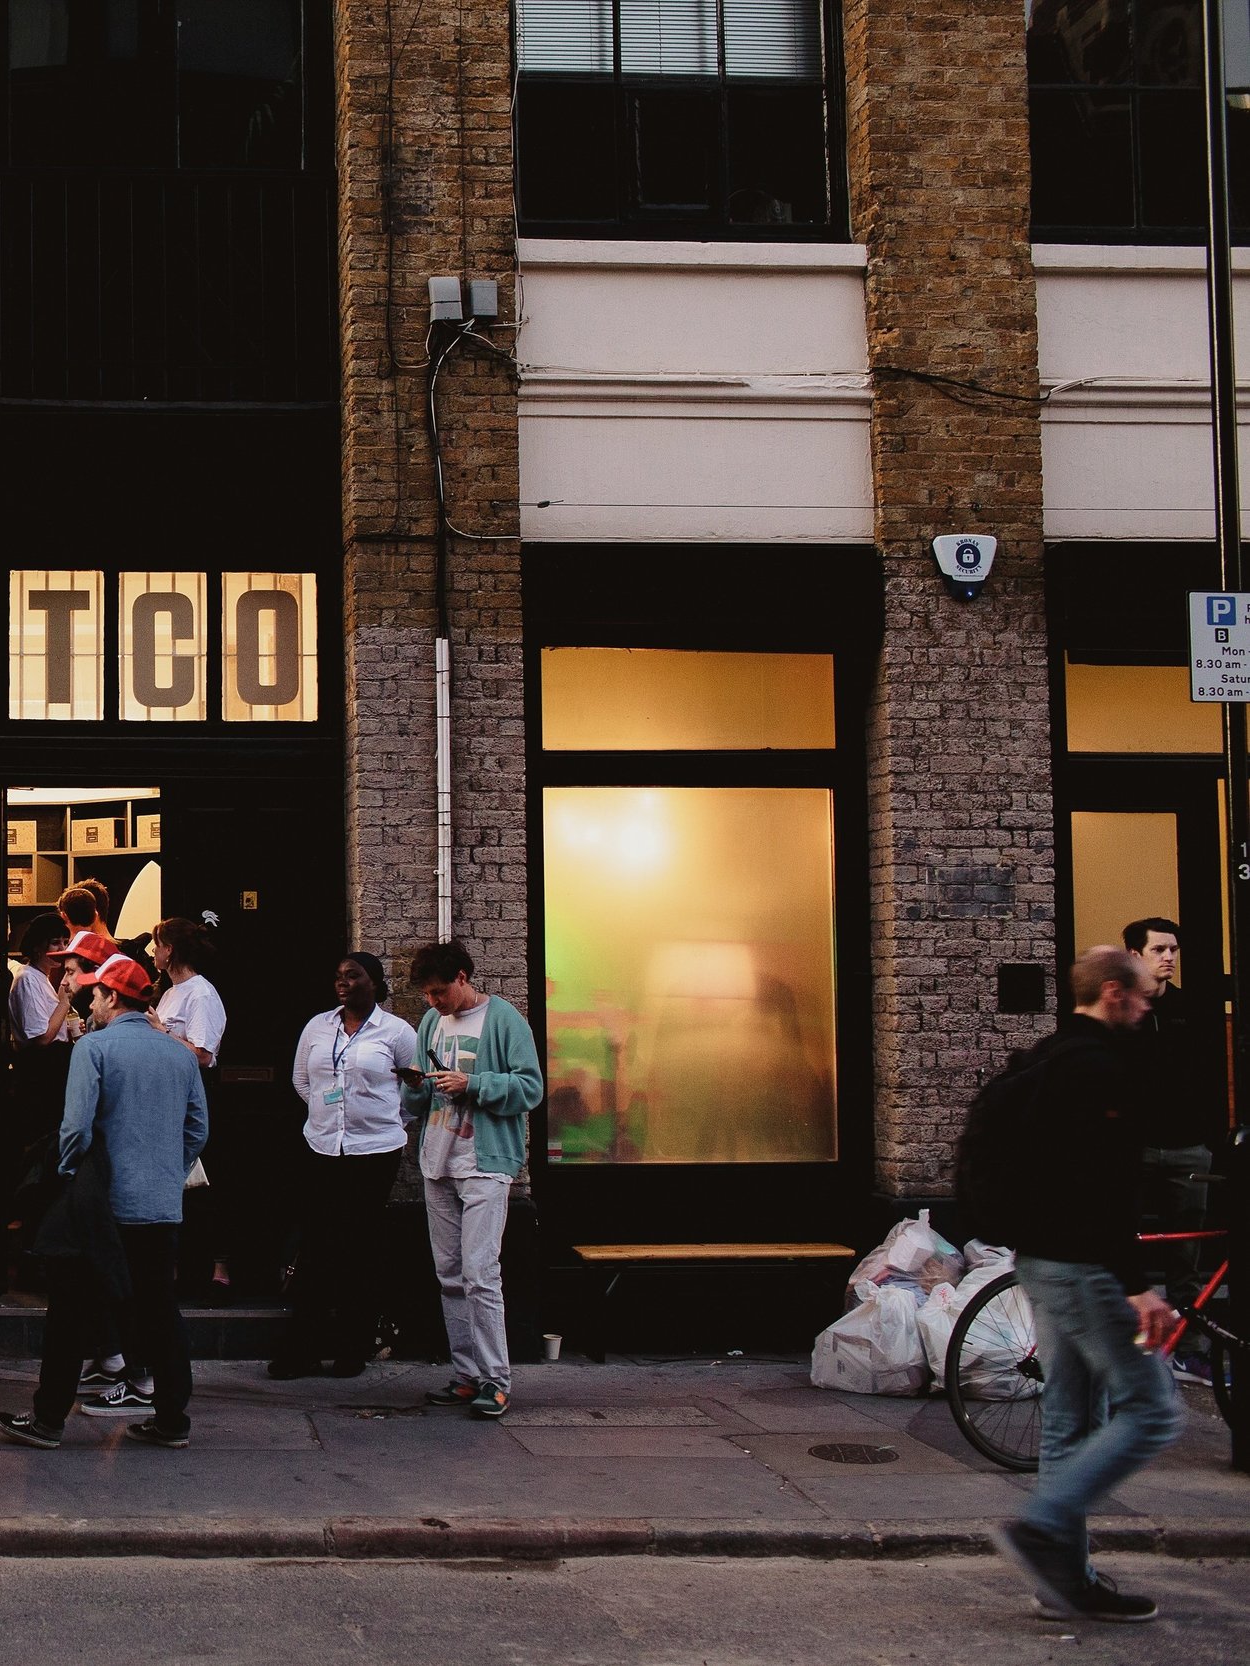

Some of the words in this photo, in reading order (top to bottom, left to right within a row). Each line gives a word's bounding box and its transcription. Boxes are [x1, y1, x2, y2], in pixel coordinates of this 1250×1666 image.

[956, 564, 983, 574] SECURITY
[1212, 600, 1231, 623] P
[1217, 630, 1227, 641] B
[28, 590, 299, 708] TCO
[1221, 646, 1246, 656] Mon
[1196, 659, 1222, 669] 8.30
[1225, 661, 1241, 669] am
[1198, 687, 1225, 697] 8.30
[1227, 689, 1243, 697] am
